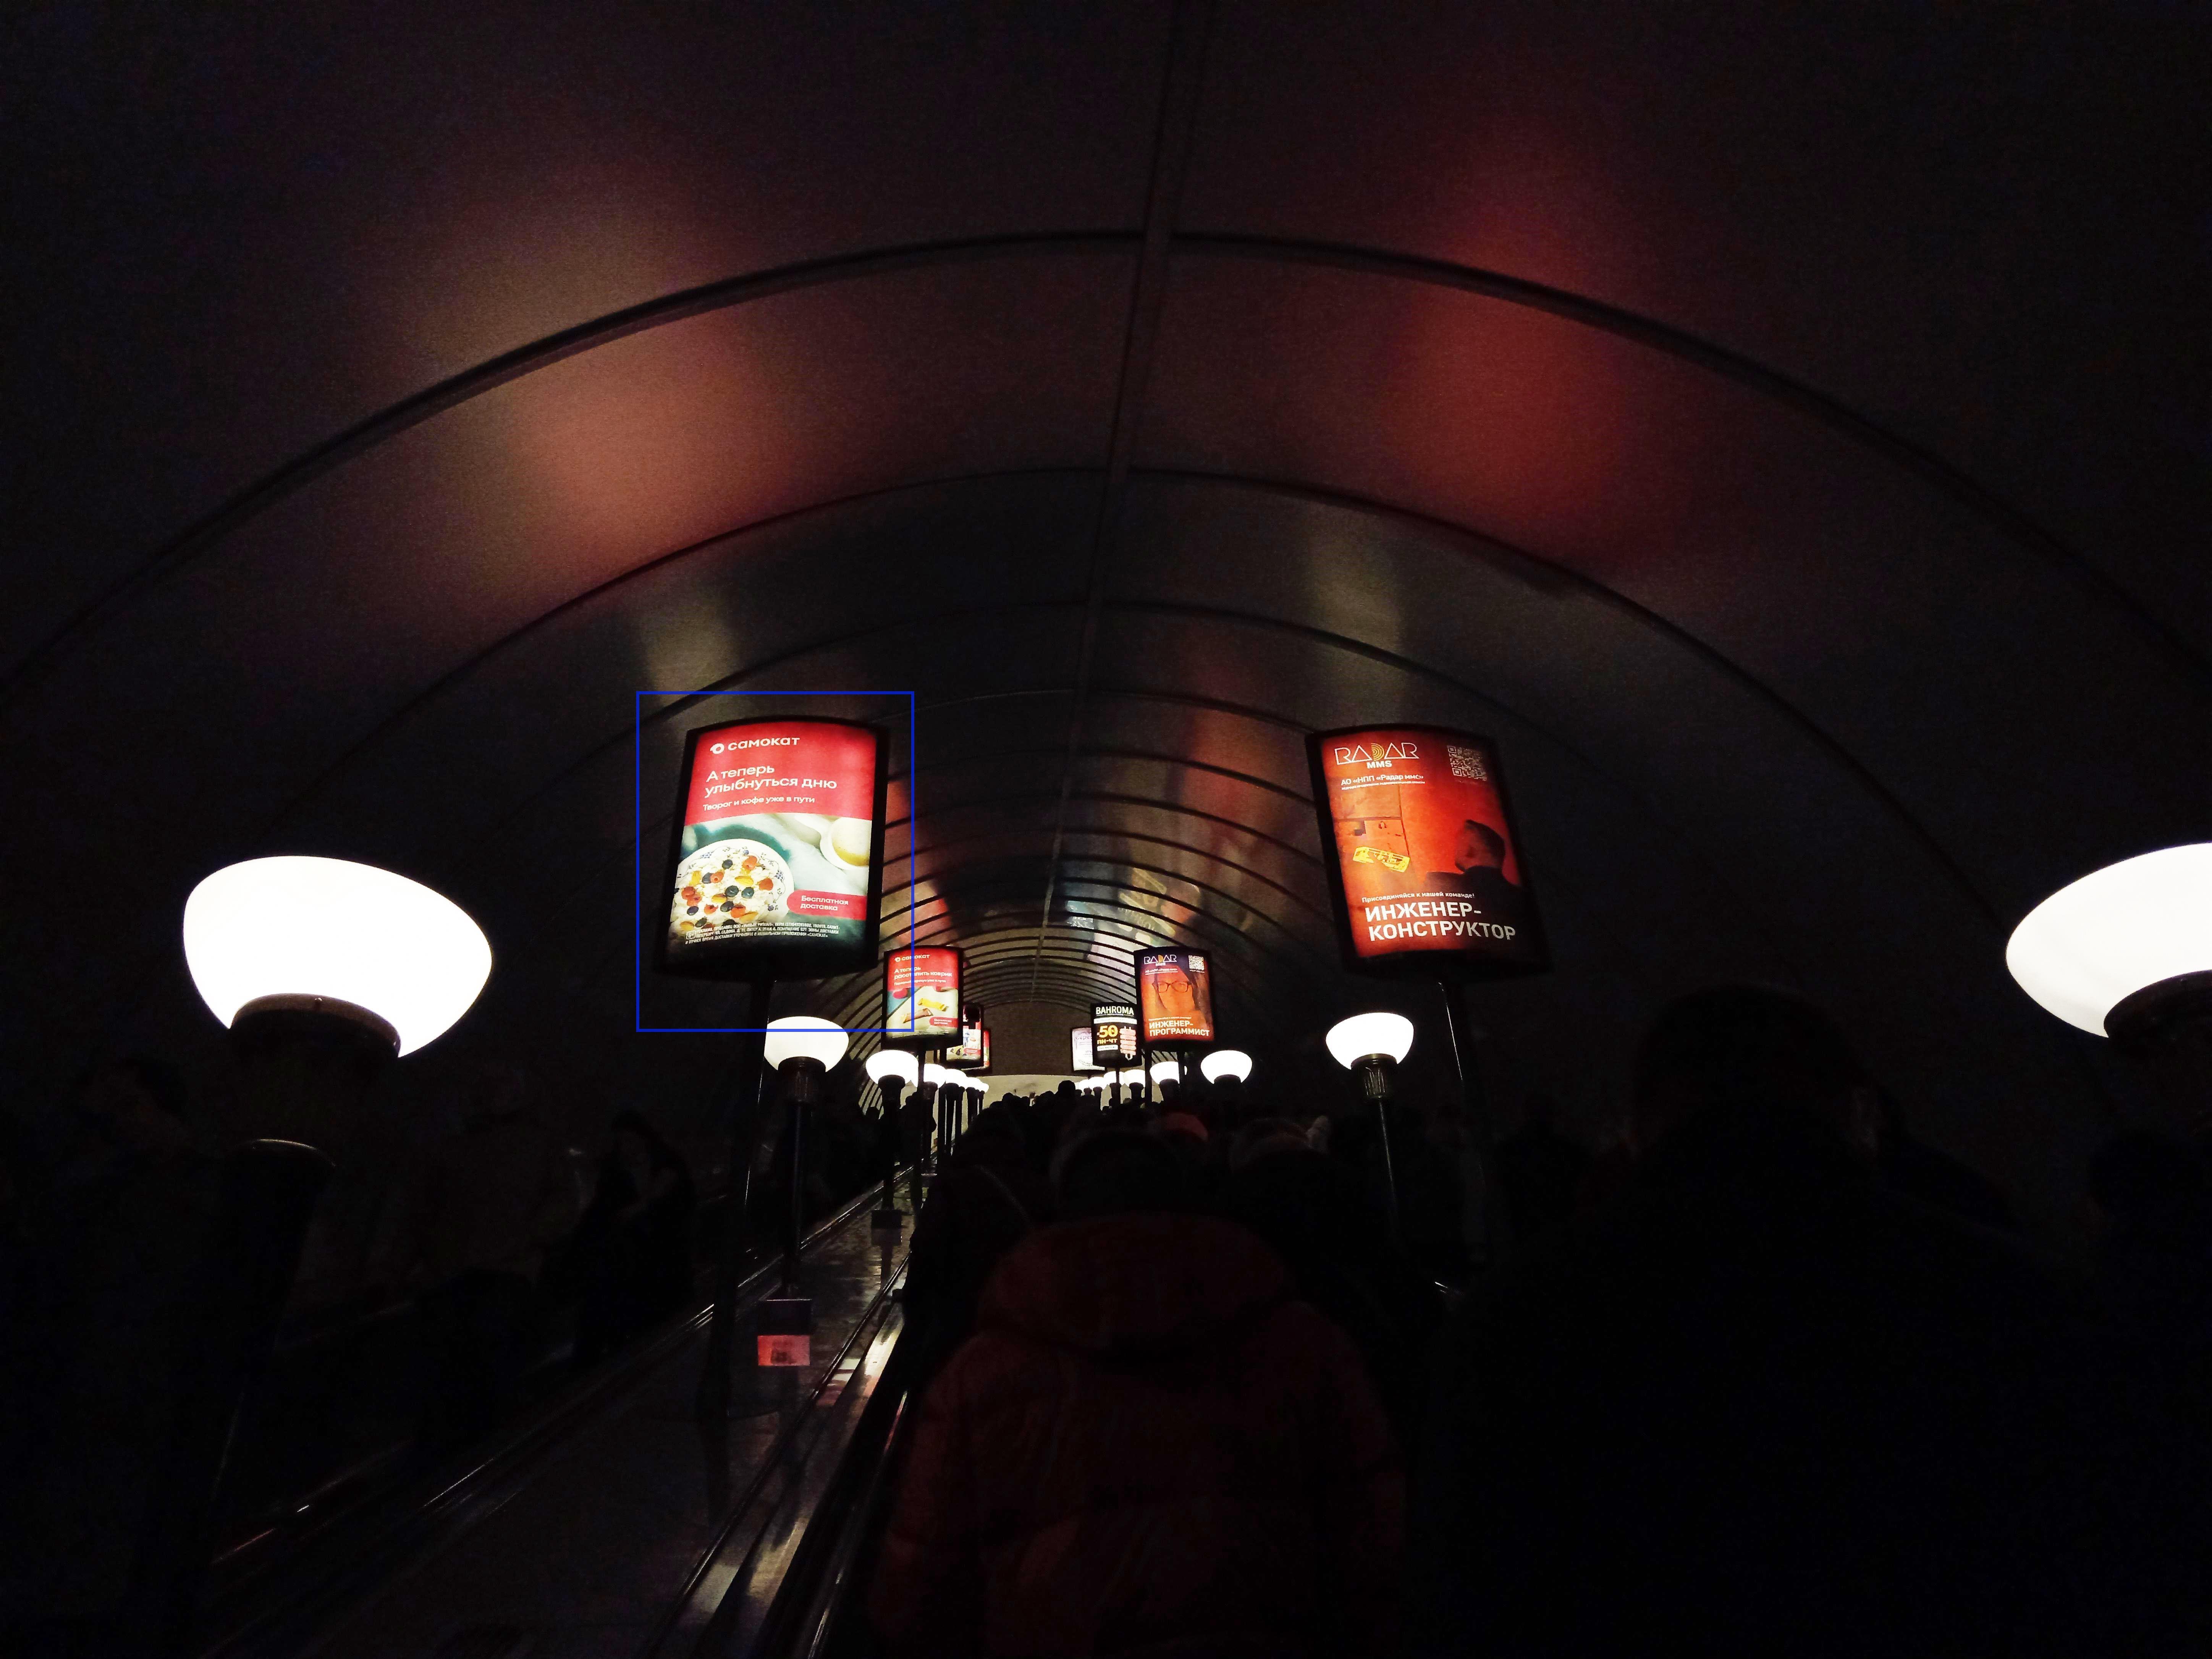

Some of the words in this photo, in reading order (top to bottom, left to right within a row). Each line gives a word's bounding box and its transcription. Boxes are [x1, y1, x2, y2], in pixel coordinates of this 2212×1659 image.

[728, 737, 800, 751] самокат
[1334, 742, 1420, 765] RADAR
[706, 771, 718, 782] А
[721, 765, 775, 779] теперь
[704, 778, 798, 798] улыбнуться
[801, 778, 837, 789] дню
[703, 801, 733, 812] Творог
[741, 796, 764, 805] кофе
[765, 796, 784, 804] уже
[801, 895, 849, 905] Бесплатная
[1361, 893, 1415, 903] Присоединяйся
[800, 902, 838, 911] доставка
[1364, 902, 1482, 922] ИНЖЕНЕР-
[1368, 920, 1516, 942] КОНСТРУКТОР
[1143, 954, 1177, 964] RADAR
[1096, 1006, 1134, 1015] BAHROMA
[1149, 1020, 1193, 1029] ИНЖЕНЕР-
[1150, 1027, 1210, 1037] ПРОГРАММИСТ
